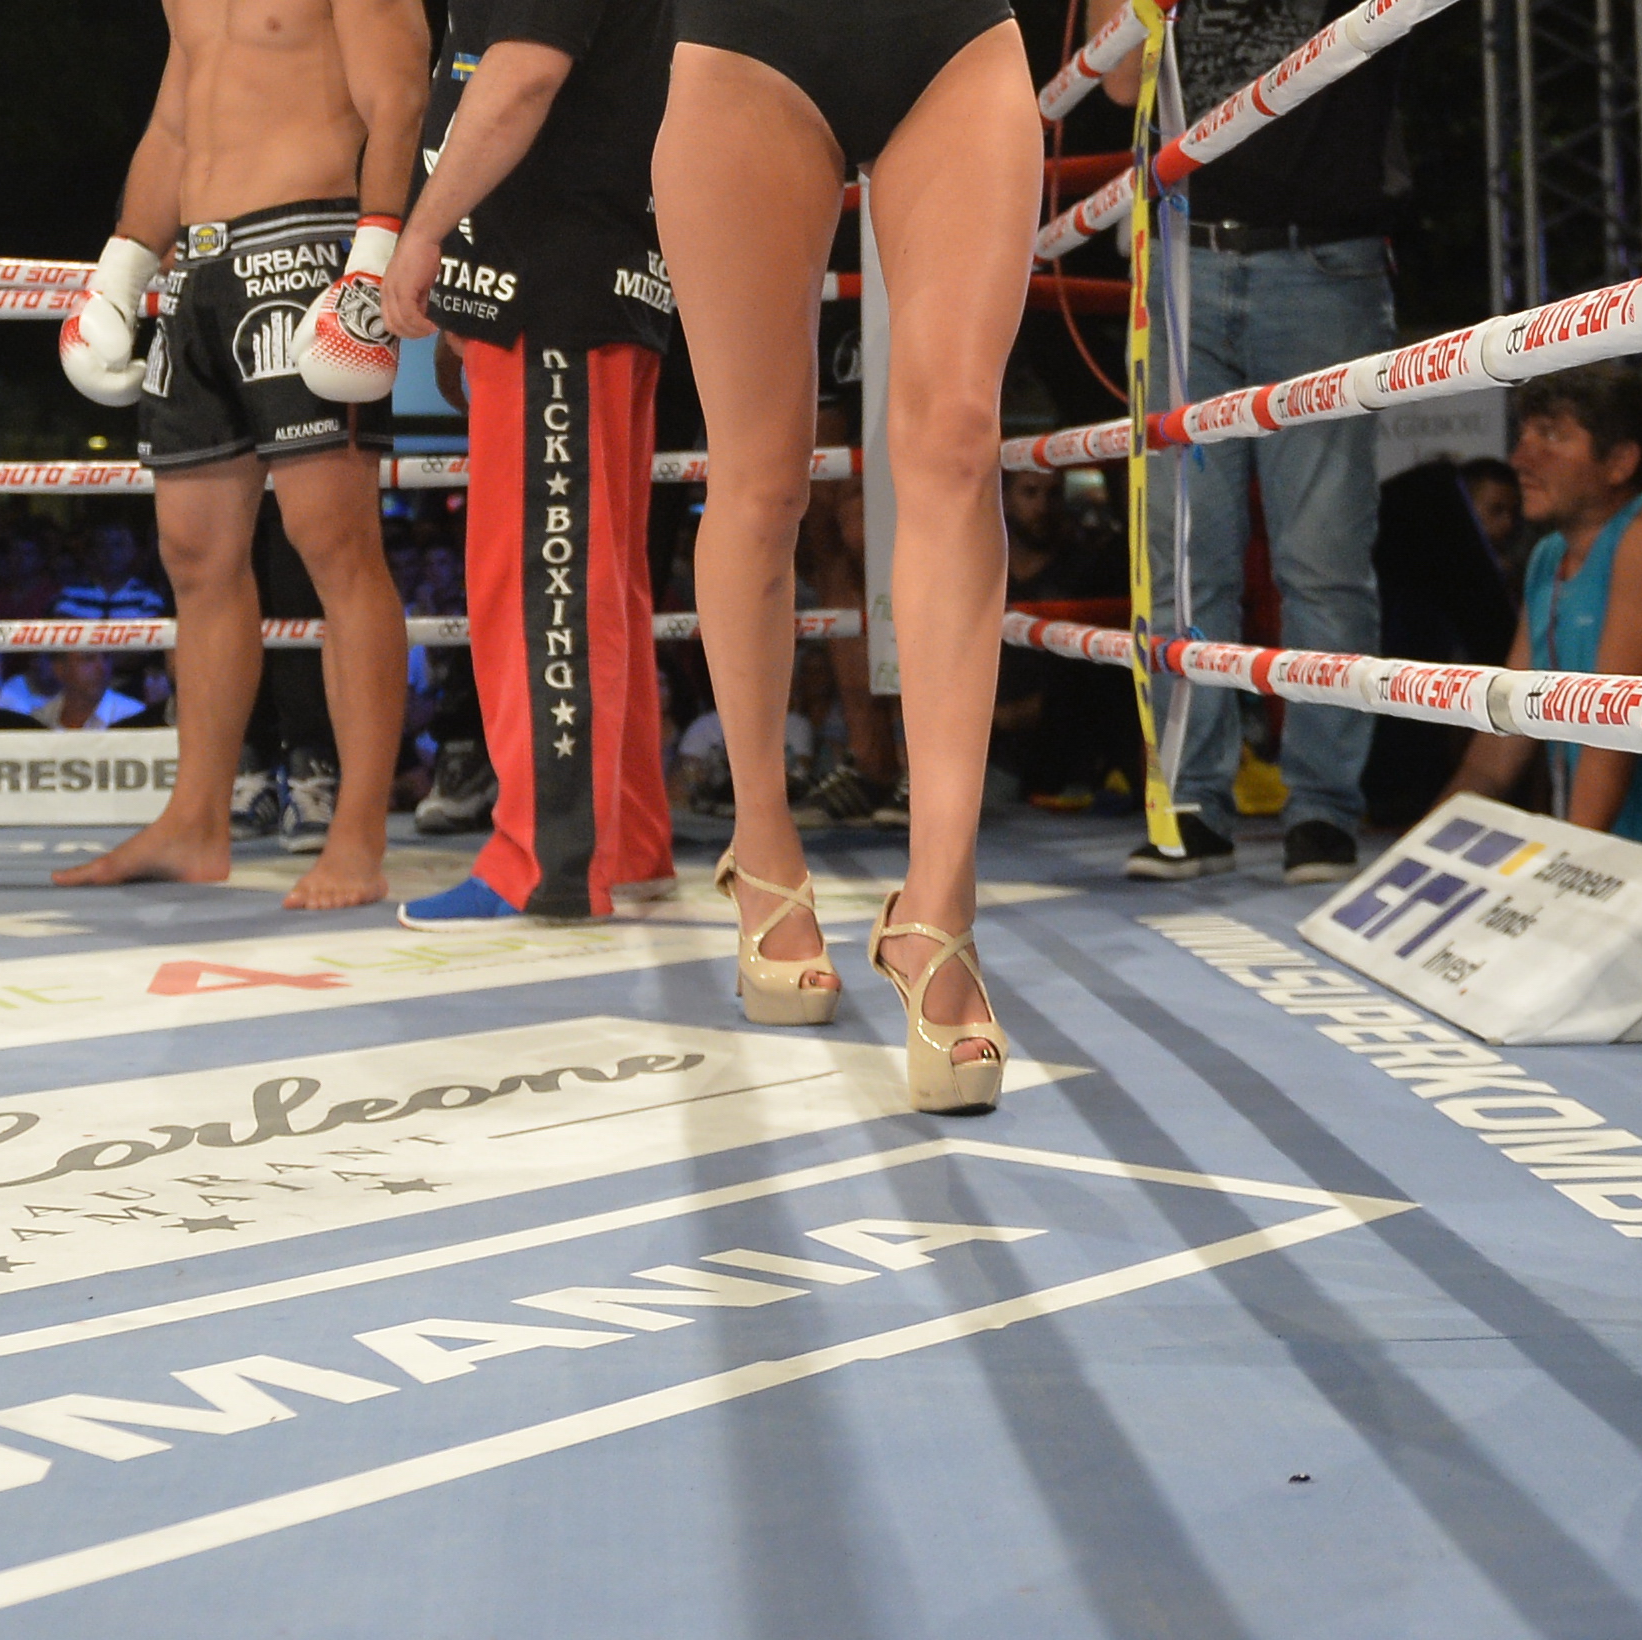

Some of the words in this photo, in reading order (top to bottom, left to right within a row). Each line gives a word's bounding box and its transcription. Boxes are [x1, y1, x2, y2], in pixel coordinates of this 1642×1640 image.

[233, 243, 340, 278] URBAN
[434, 256, 518, 302] TARS
[244, 268, 333, 298] RAHOVA
[442, 294, 500, 322] CENTER
[542, 505, 575, 691] BOXING
[1533, 851, 1625, 901] European
[1478, 896, 1543, 938] Funds
